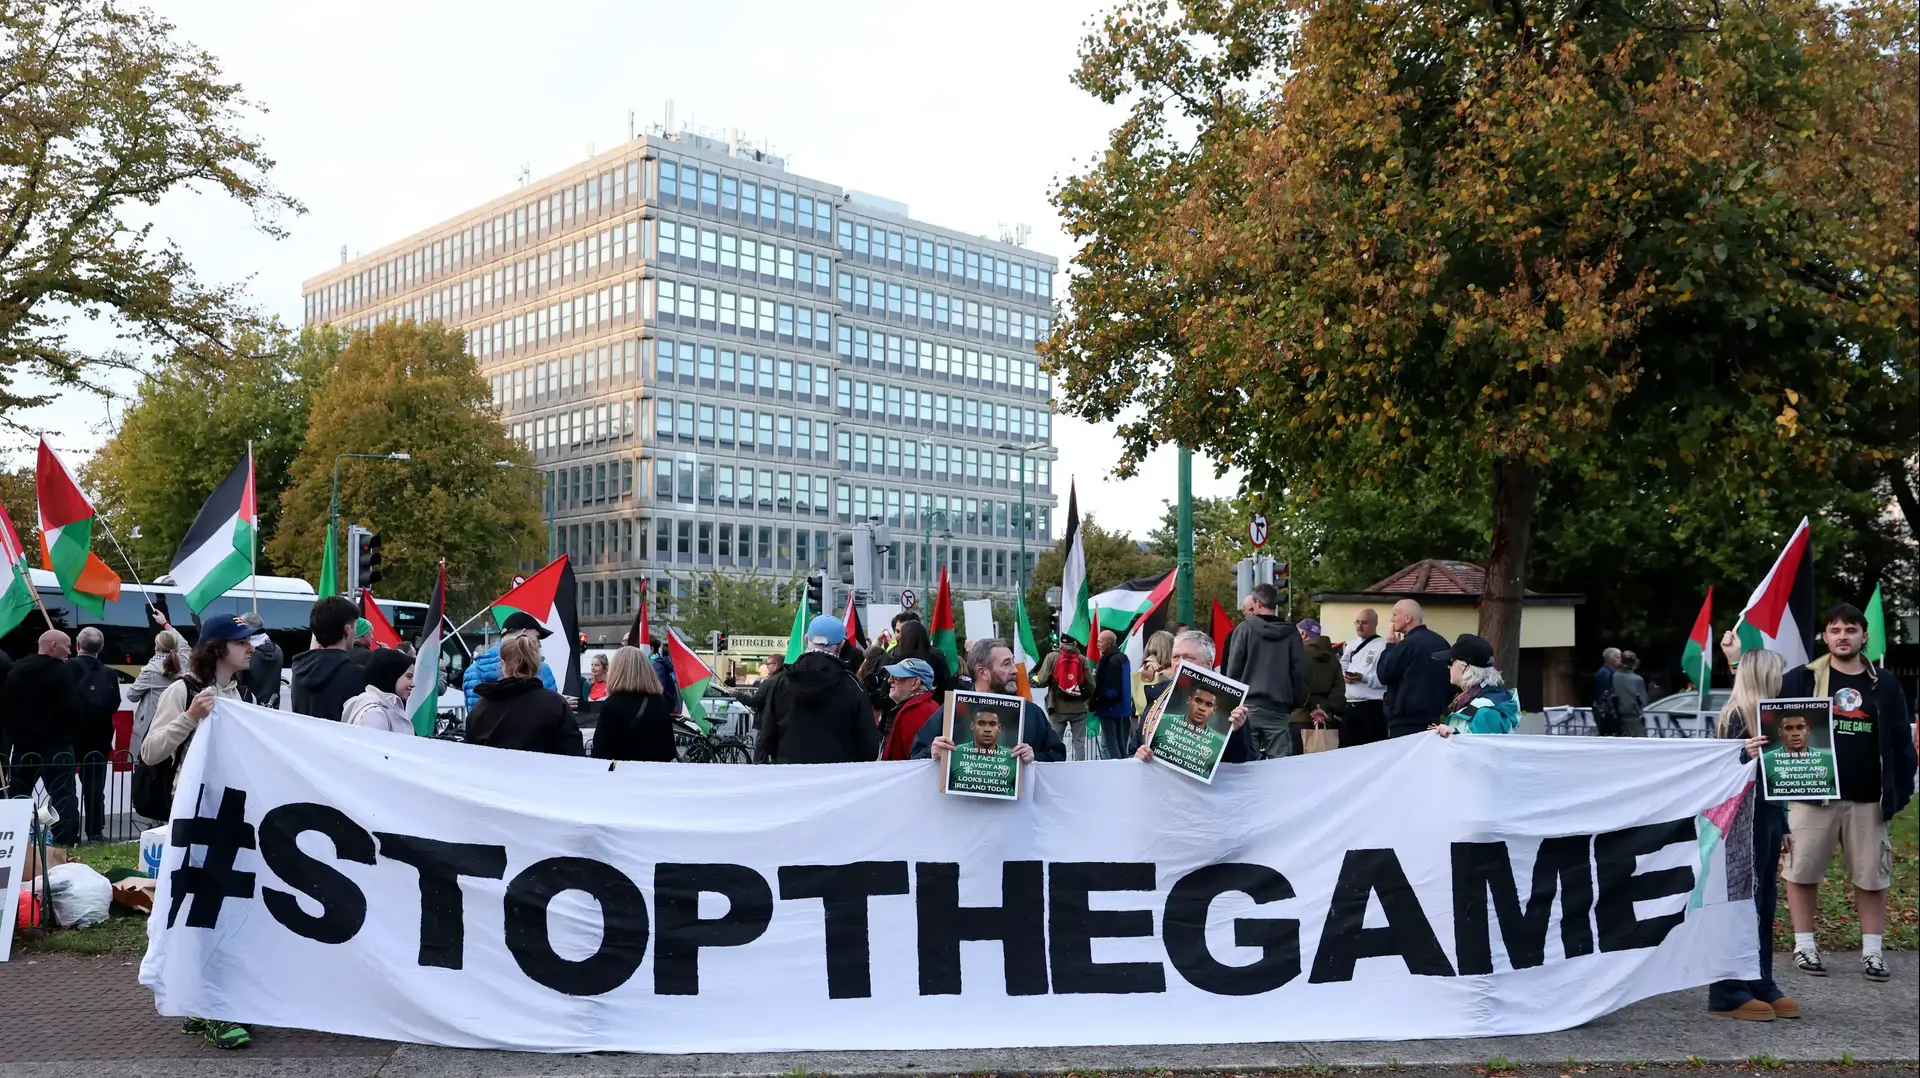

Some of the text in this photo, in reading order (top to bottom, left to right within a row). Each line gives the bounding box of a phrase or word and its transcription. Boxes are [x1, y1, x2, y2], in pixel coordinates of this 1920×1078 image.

[1182, 669, 1242, 697] REAL IRISH HERO
[1170, 724, 1183, 734] THE
[1184, 729, 1201, 740] FACE
[1172, 717, 1187, 728] THIS
[1196, 726, 1215, 738] WHAT
[1839, 720, 1852, 730] THE
[1853, 721, 1872, 732] GAME
[1165, 730, 1196, 747] BRAVERY
[1154, 749, 1206, 774] IRELAND TODAY
[1159, 743, 1181, 756] LOOKS
[1182, 752, 1198, 762] LIKE
[167, 783, 1697, 999] #STOPTHEGAME
